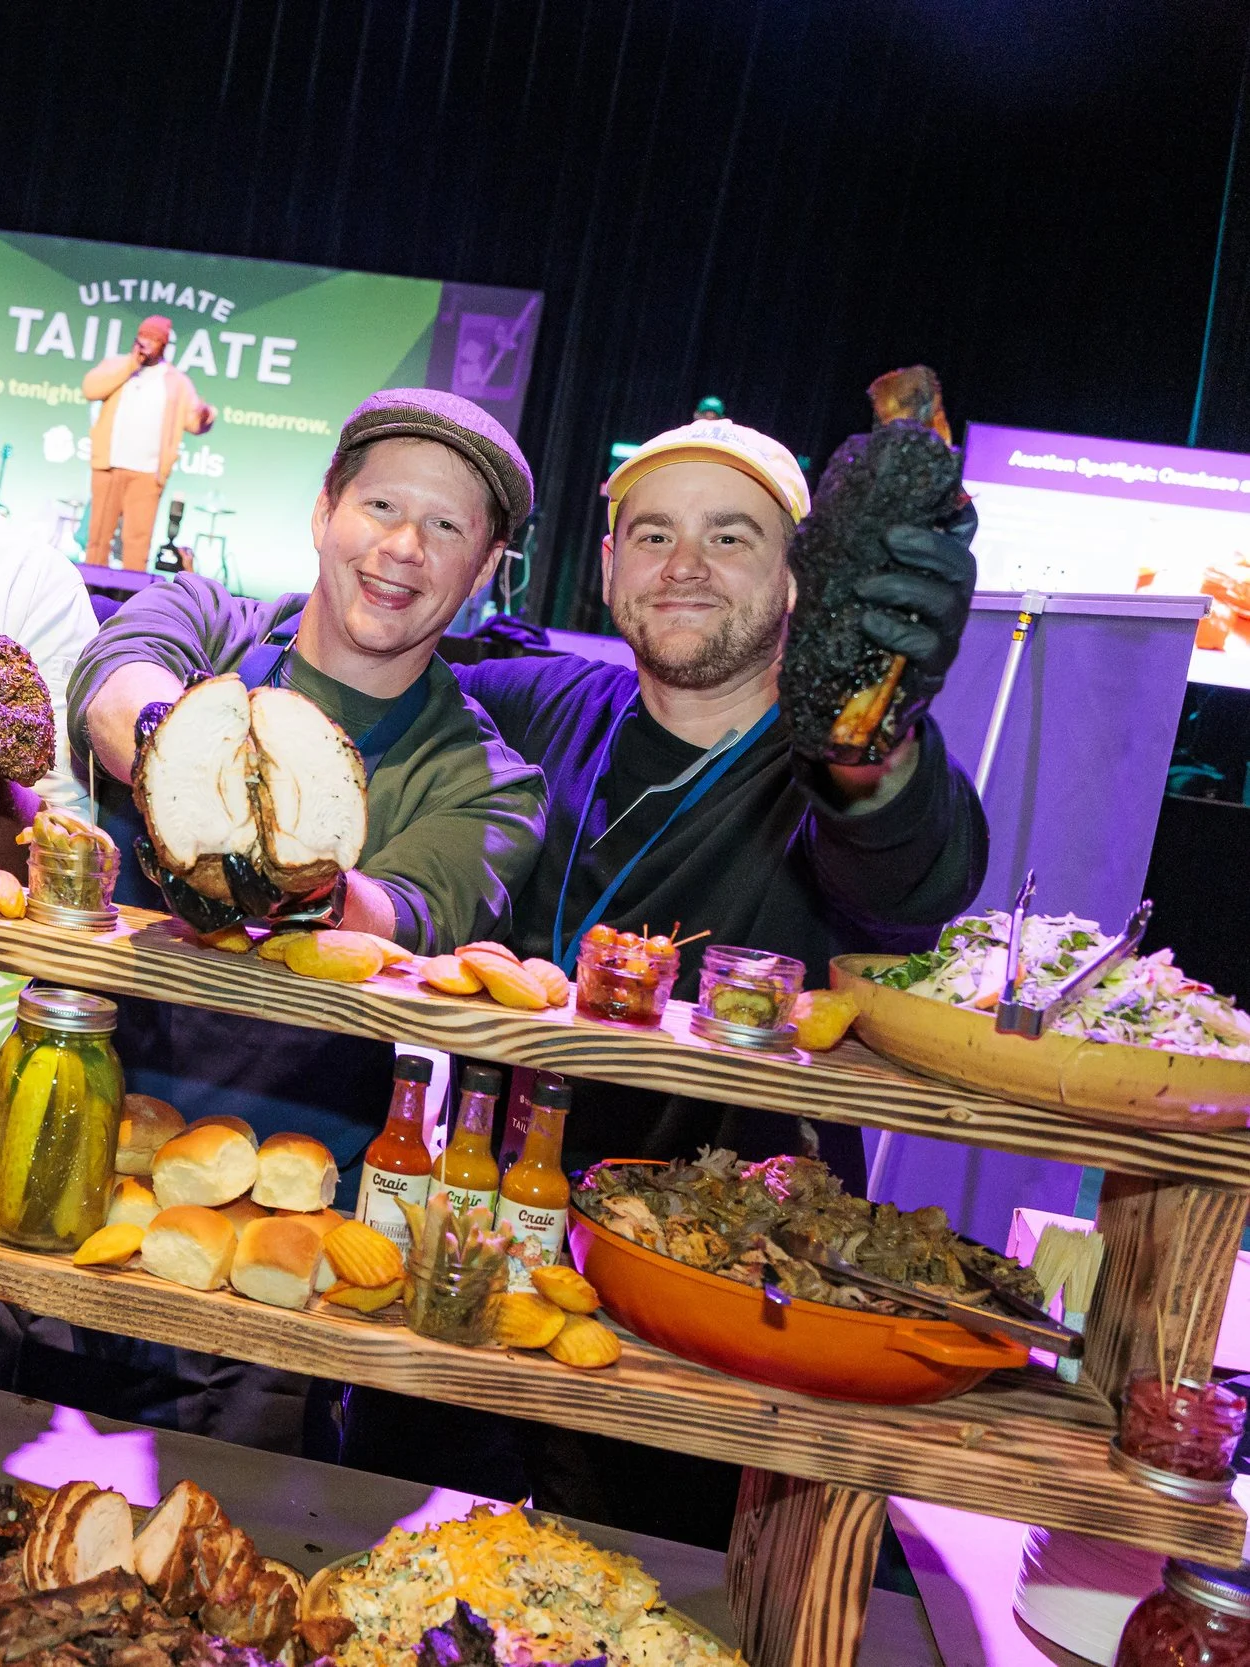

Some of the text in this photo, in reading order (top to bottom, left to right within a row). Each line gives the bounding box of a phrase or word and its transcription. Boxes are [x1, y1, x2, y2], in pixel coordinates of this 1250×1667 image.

[78, 278, 236, 324] ULTIMATE
[222, 405, 333, 435] tomorrow.
[512, 1117, 527, 1134] TAIL
[372, 1172, 408, 1191] Craic
[518, 1209, 555, 1226] Craic
